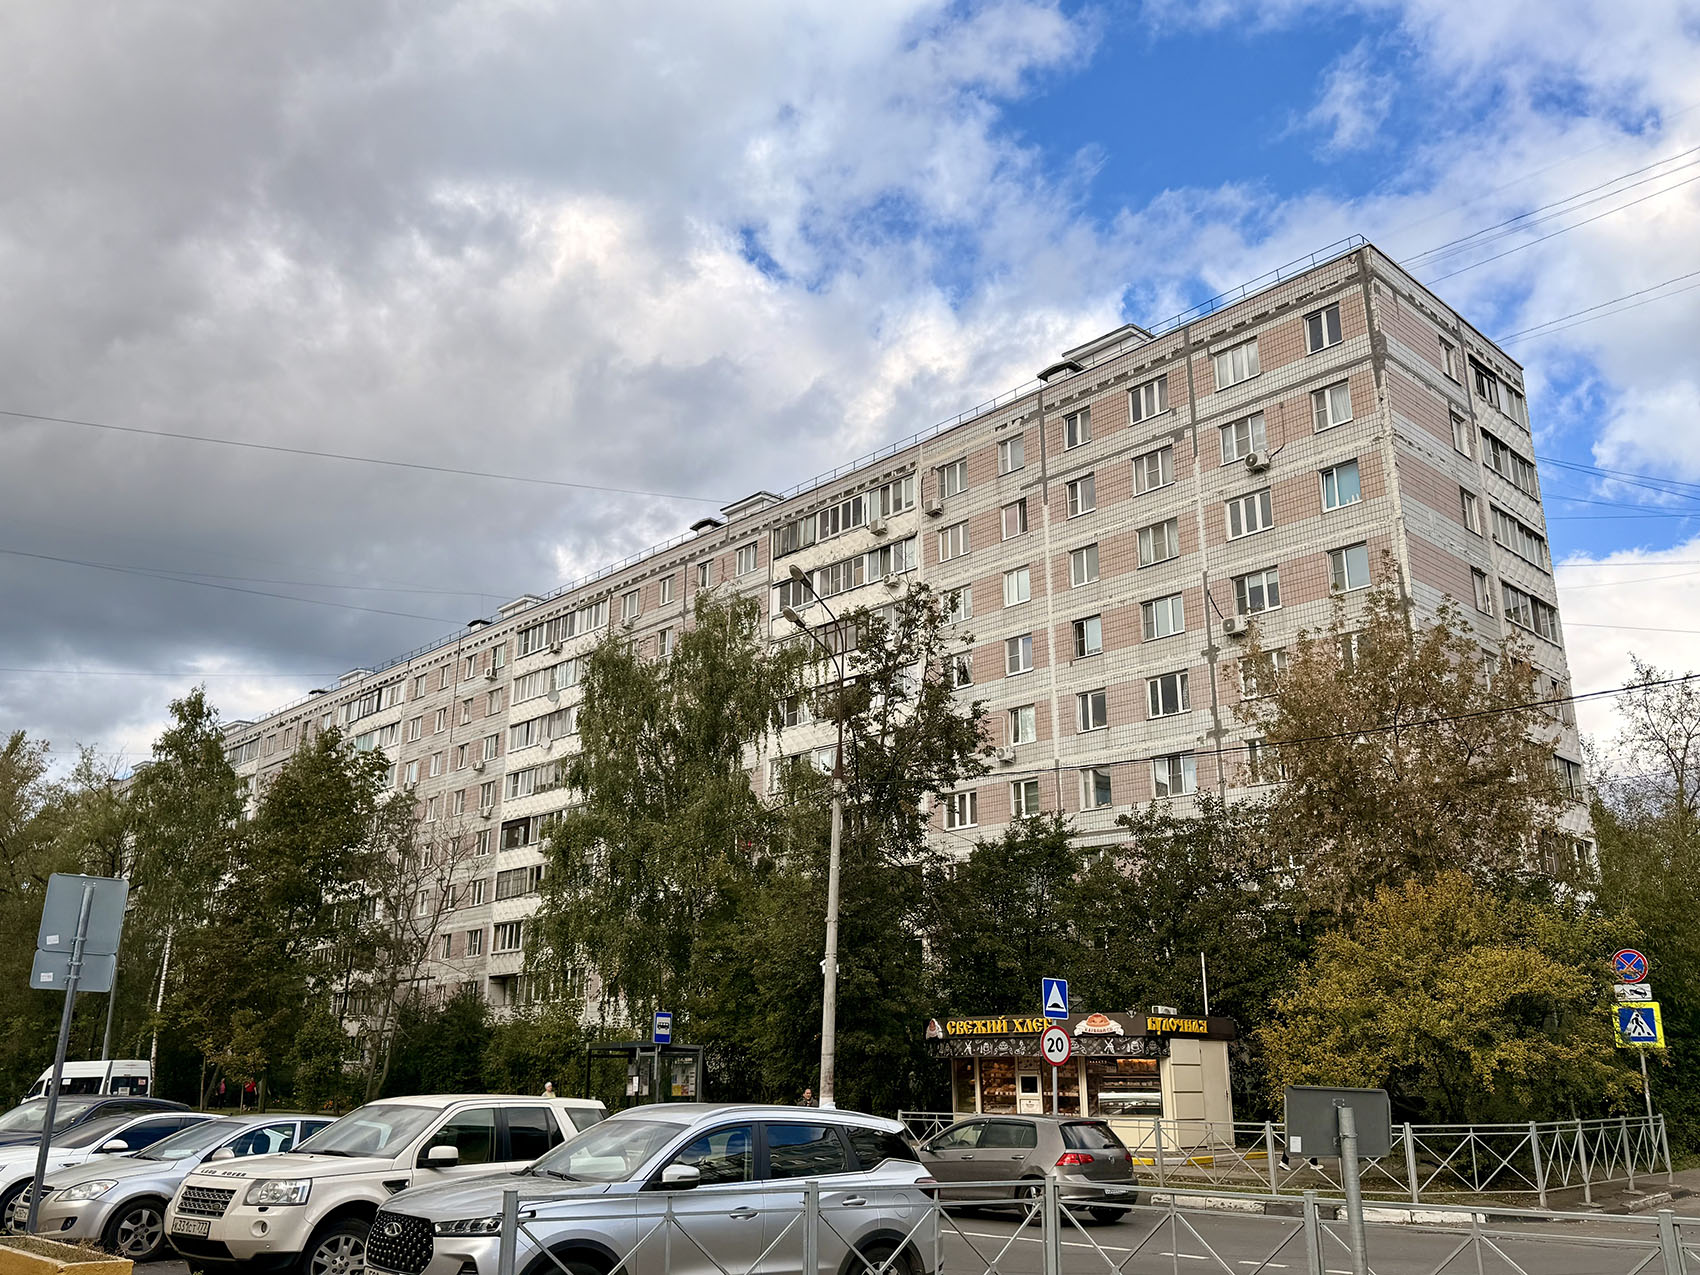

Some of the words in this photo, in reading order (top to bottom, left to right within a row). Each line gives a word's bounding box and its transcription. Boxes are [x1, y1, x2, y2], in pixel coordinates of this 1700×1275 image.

[946, 1015, 1008, 1035] СВЕЖИЙ
[1146, 1016, 1208, 1035] БУЛОЧНАЯ
[1047, 1036, 1064, 1053] 20
